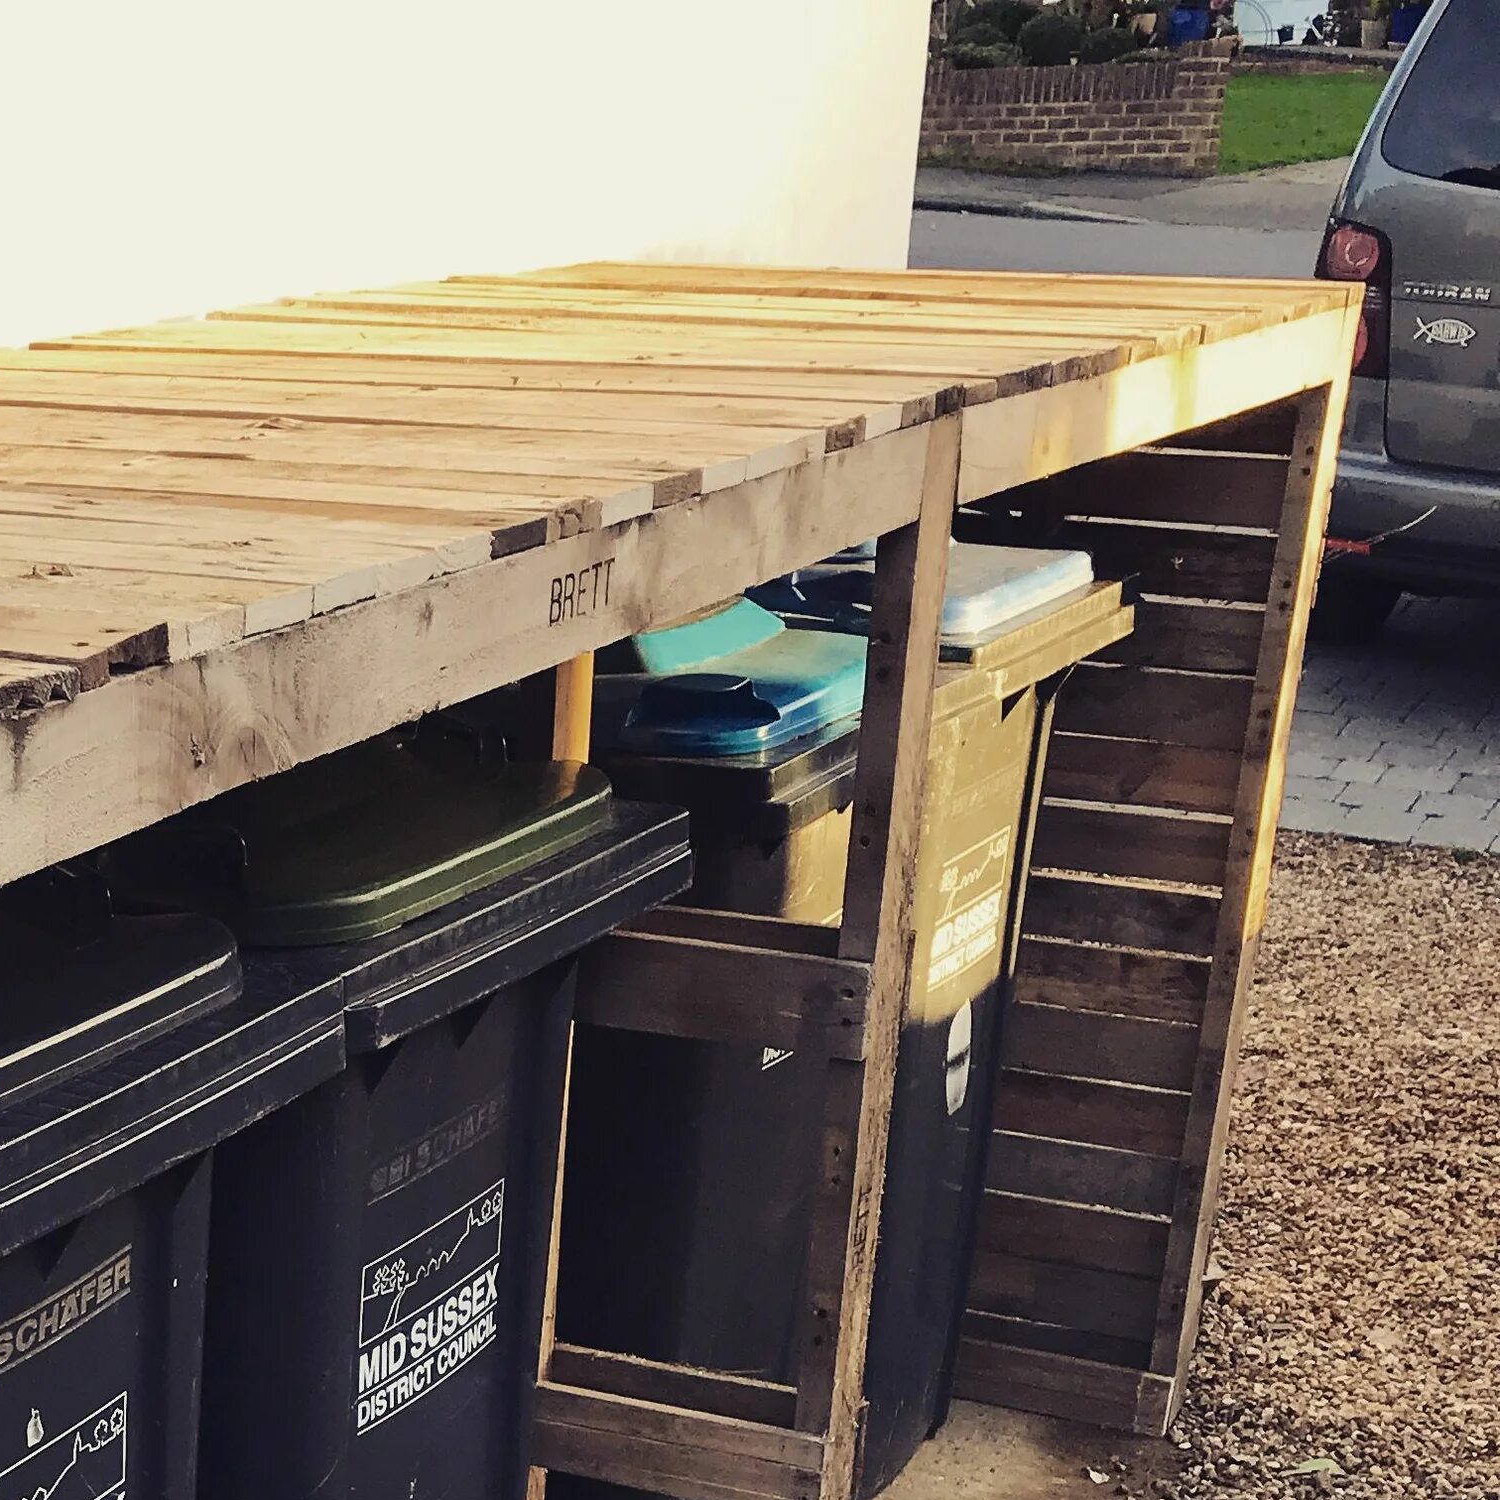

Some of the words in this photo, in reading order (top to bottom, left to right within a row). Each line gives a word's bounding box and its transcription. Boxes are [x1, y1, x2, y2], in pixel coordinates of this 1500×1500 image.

[549, 557, 616, 627] BRETT
[357, 1357, 435, 1428] DISTRICT
[437, 1311, 497, 1375] COUNCIL
[358, 1332, 407, 1393] MID
[410, 1263, 499, 1358] SUSSEX
